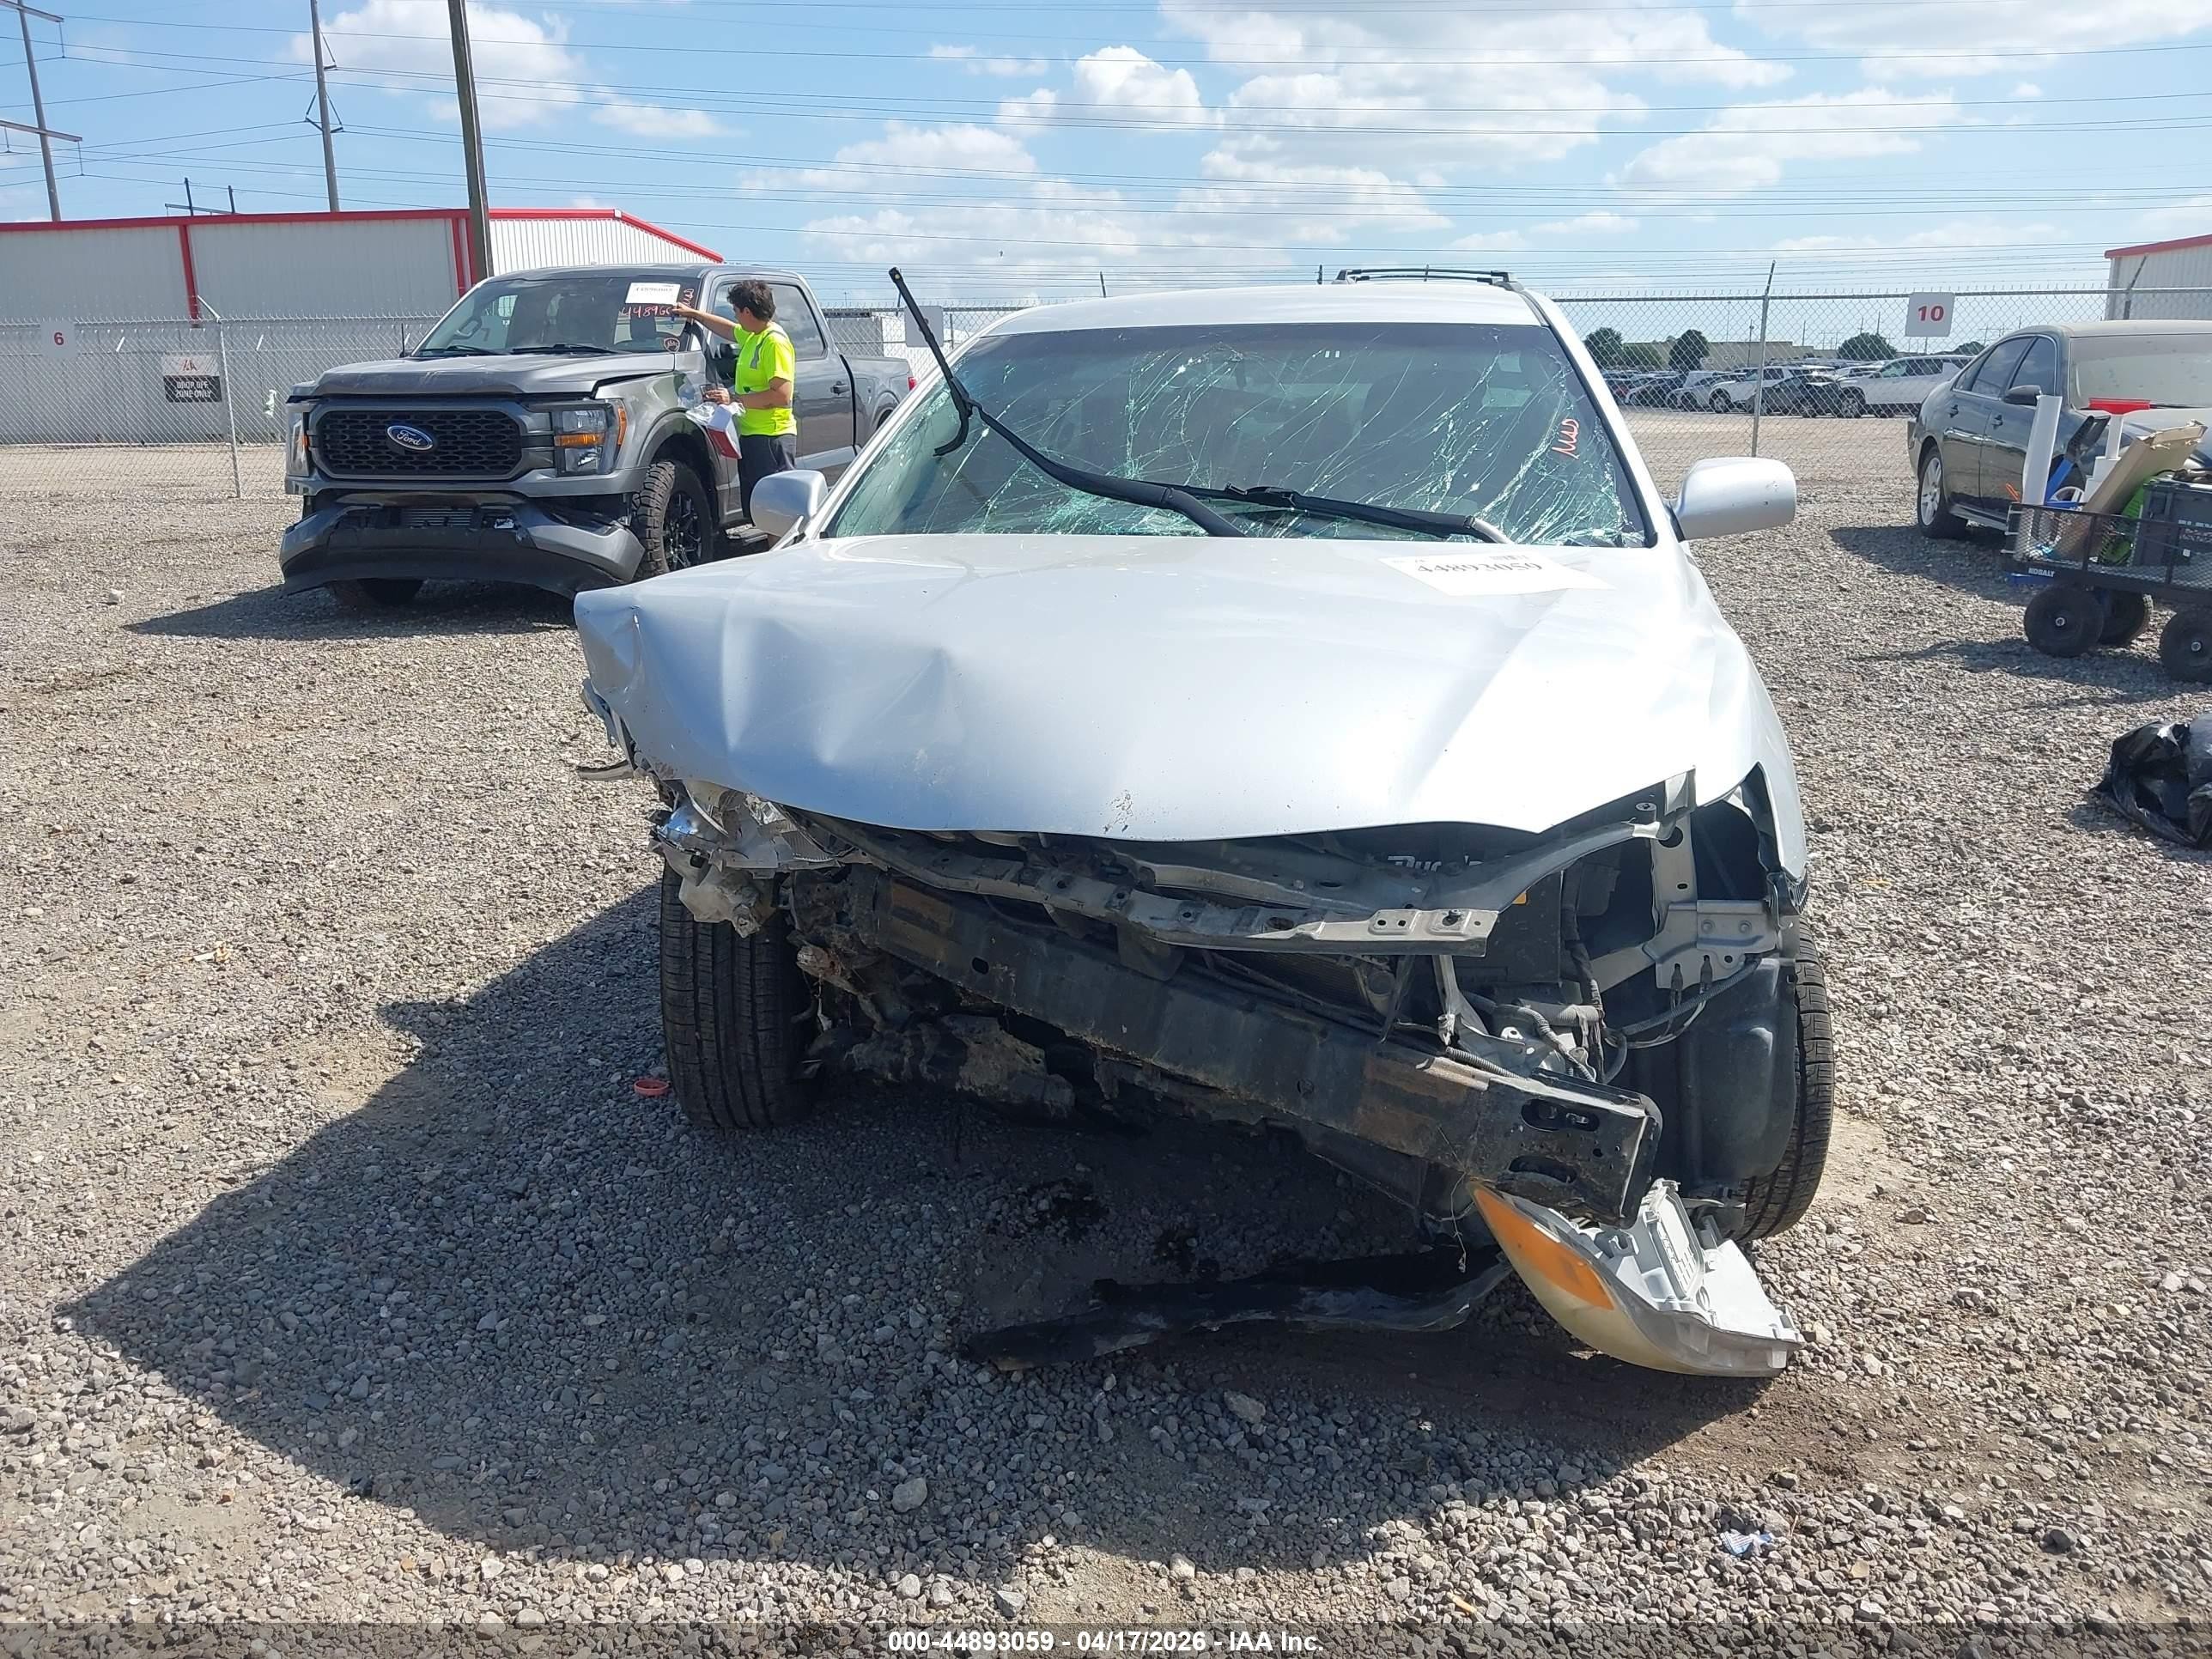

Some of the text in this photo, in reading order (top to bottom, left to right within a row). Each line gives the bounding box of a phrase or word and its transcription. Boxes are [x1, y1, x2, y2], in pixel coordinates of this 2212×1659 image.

[1918, 305, 1944, 322] 10
[54, 331, 64, 346] 6
[196, 380, 209, 389] OFF
[2028, 568, 2055, 577] KOBALT
